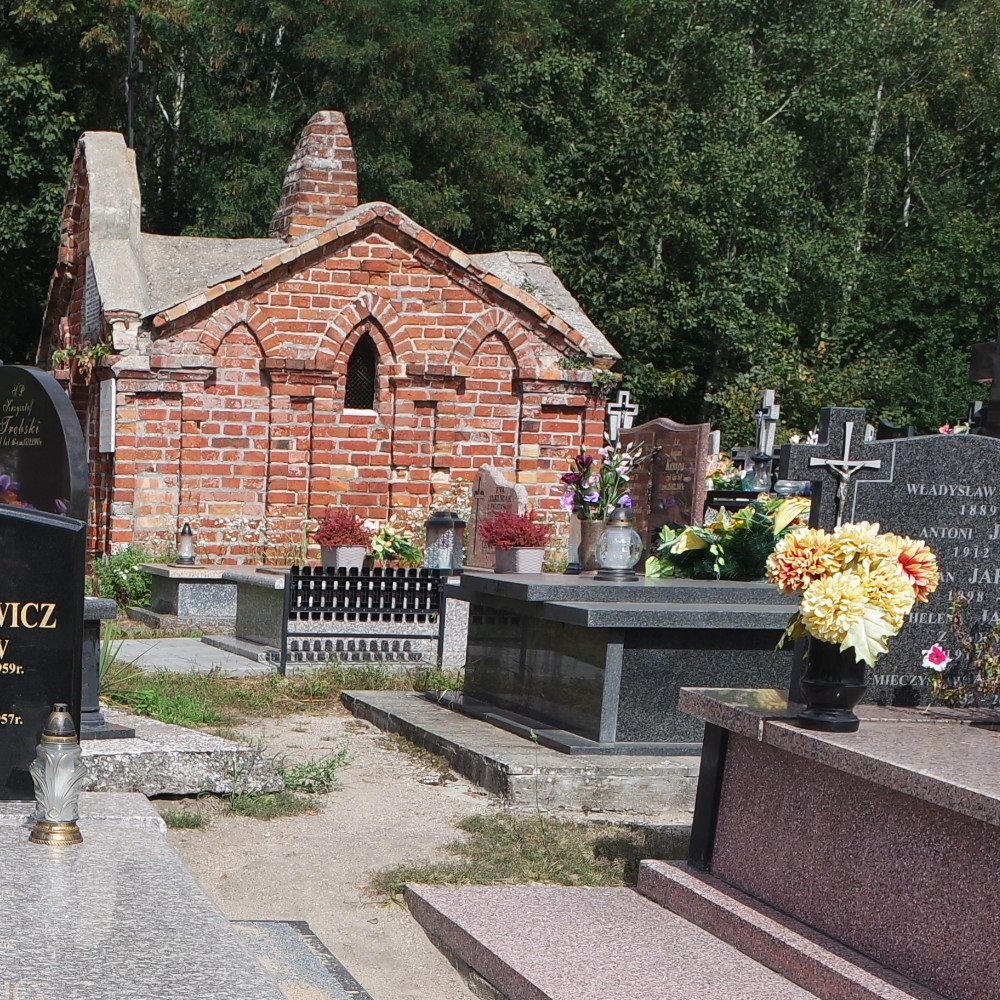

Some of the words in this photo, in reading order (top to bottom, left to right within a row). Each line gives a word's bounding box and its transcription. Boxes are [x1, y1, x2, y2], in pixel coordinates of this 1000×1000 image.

[960, 504, 997, 516] 1889
[919, 526, 974, 540] ANTONI
[953, 546, 990, 559] 1912
